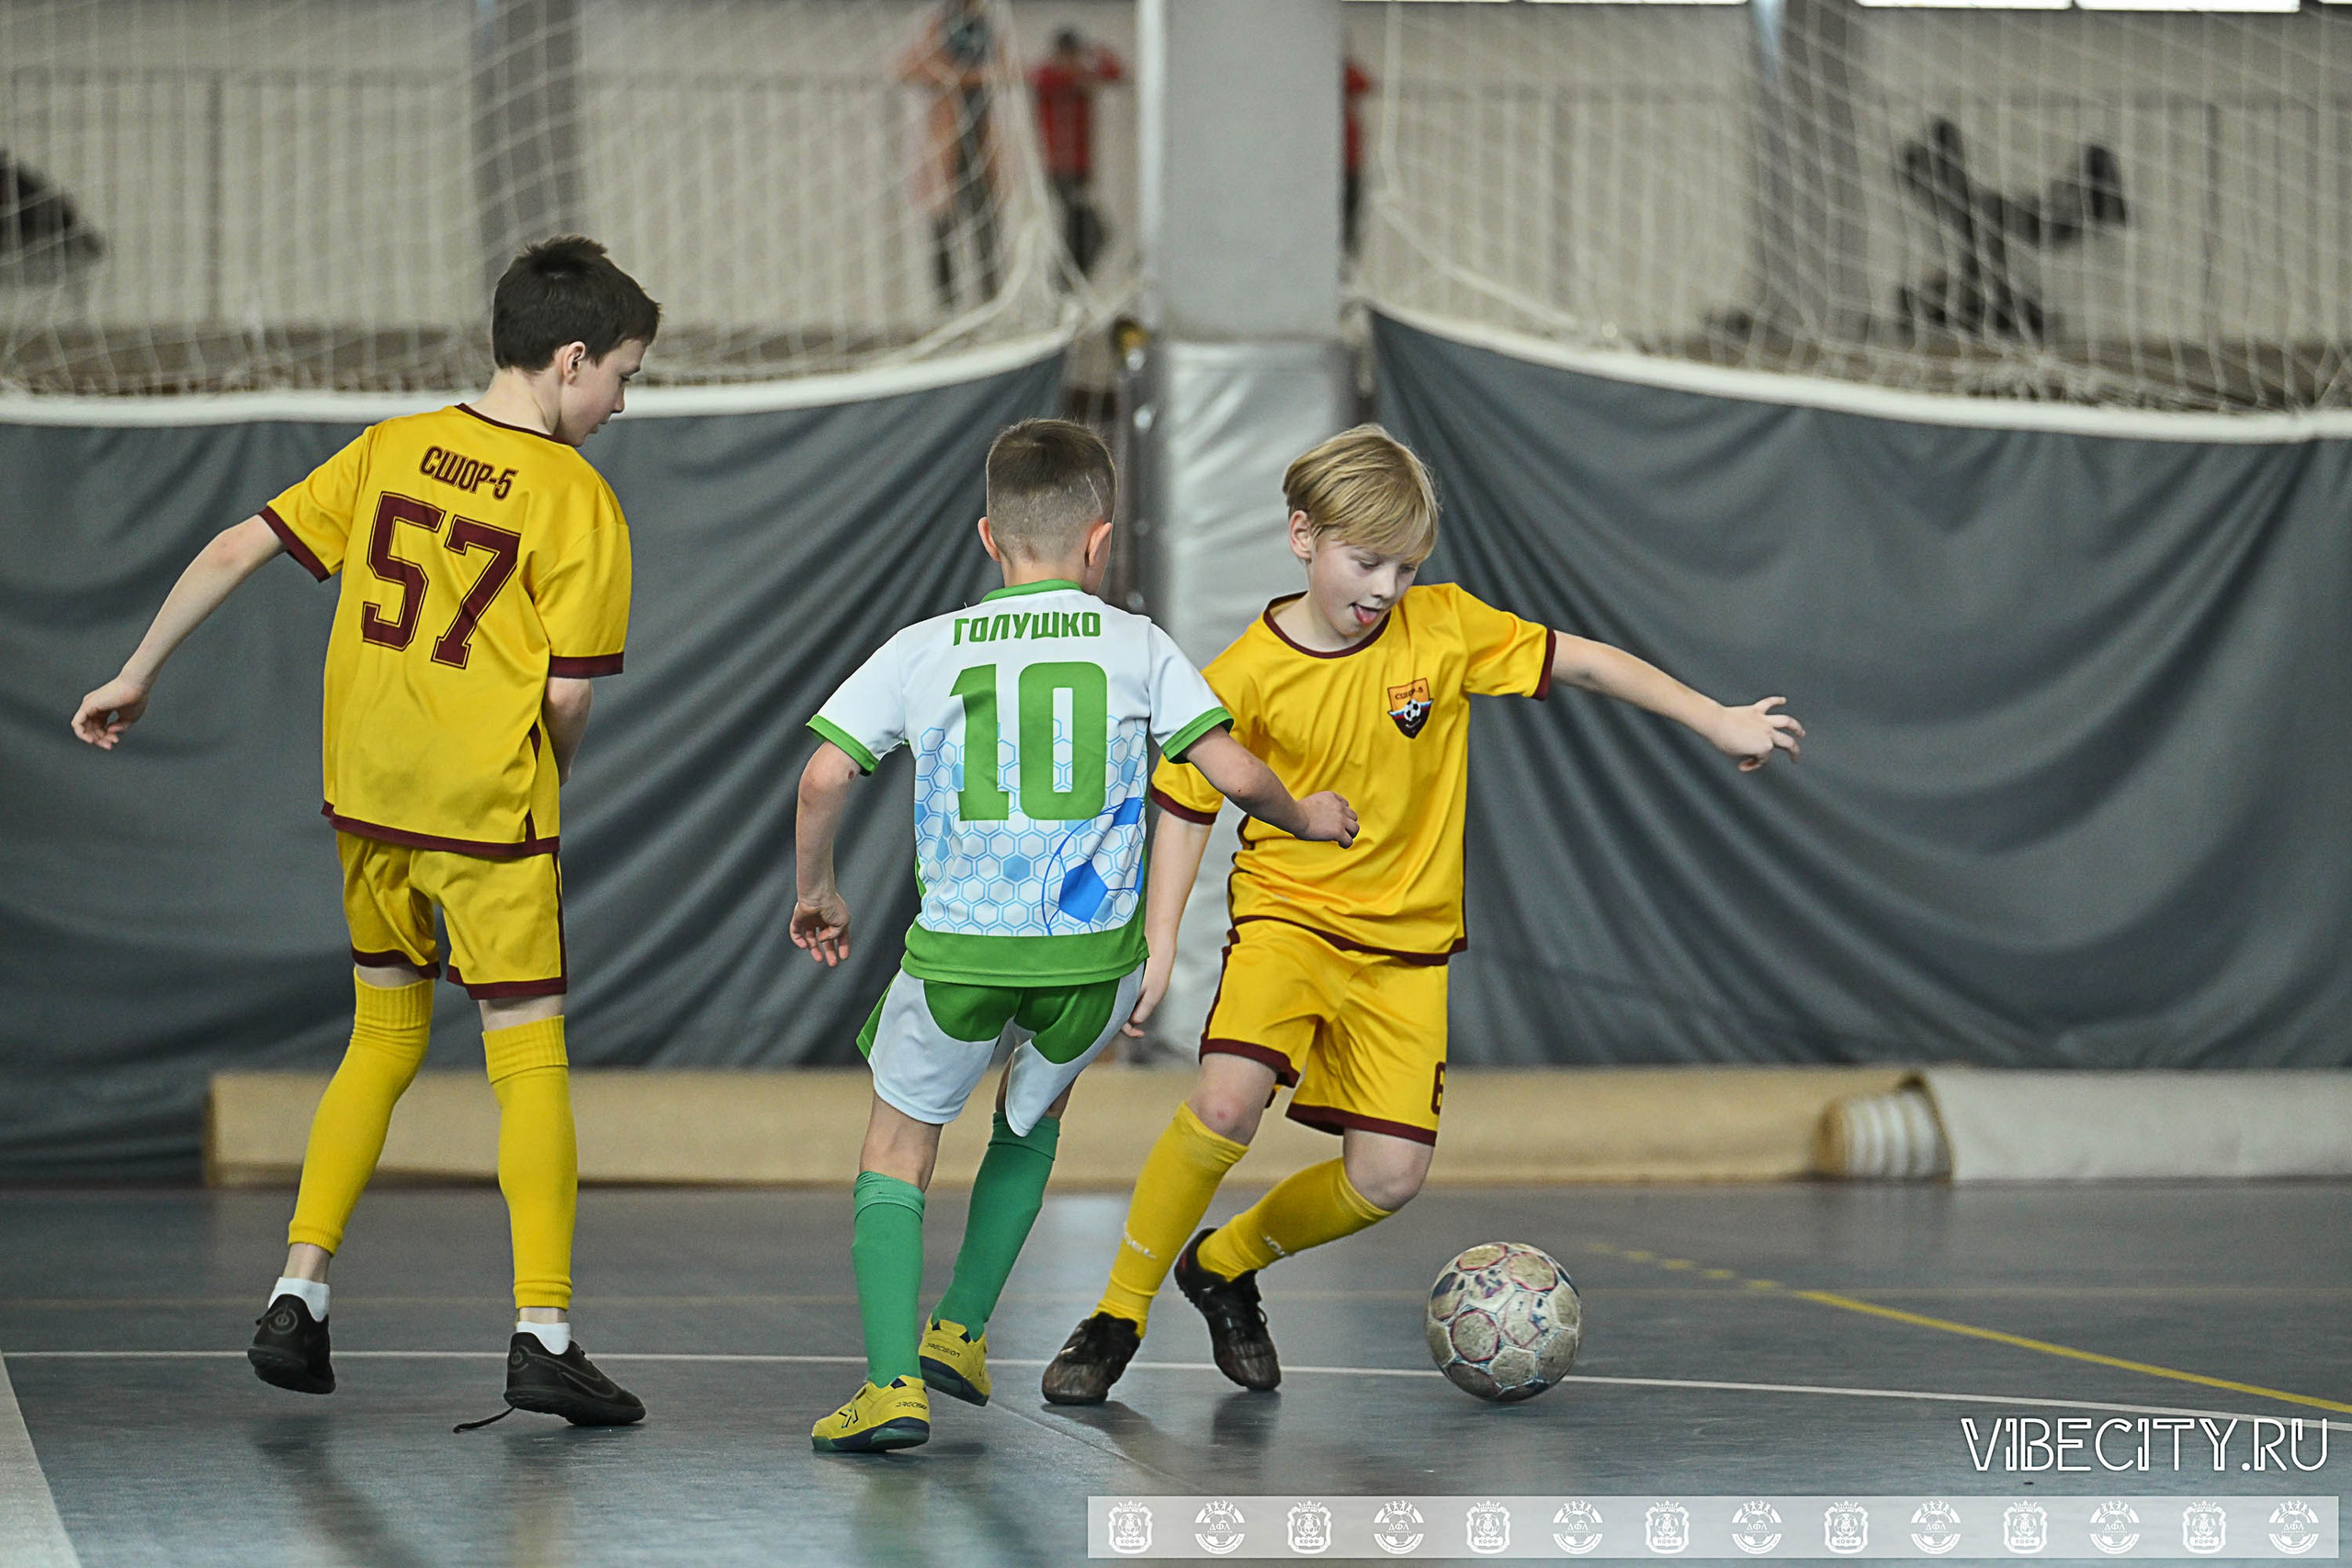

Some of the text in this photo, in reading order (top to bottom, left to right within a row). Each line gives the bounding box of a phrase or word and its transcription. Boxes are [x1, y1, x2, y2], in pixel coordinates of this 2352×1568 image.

[418, 445, 519, 501] СШОР-5
[361, 491, 522, 670] 57
[953, 612, 1102, 646] ГОЛУШКО
[949, 661, 1108, 821] 10
